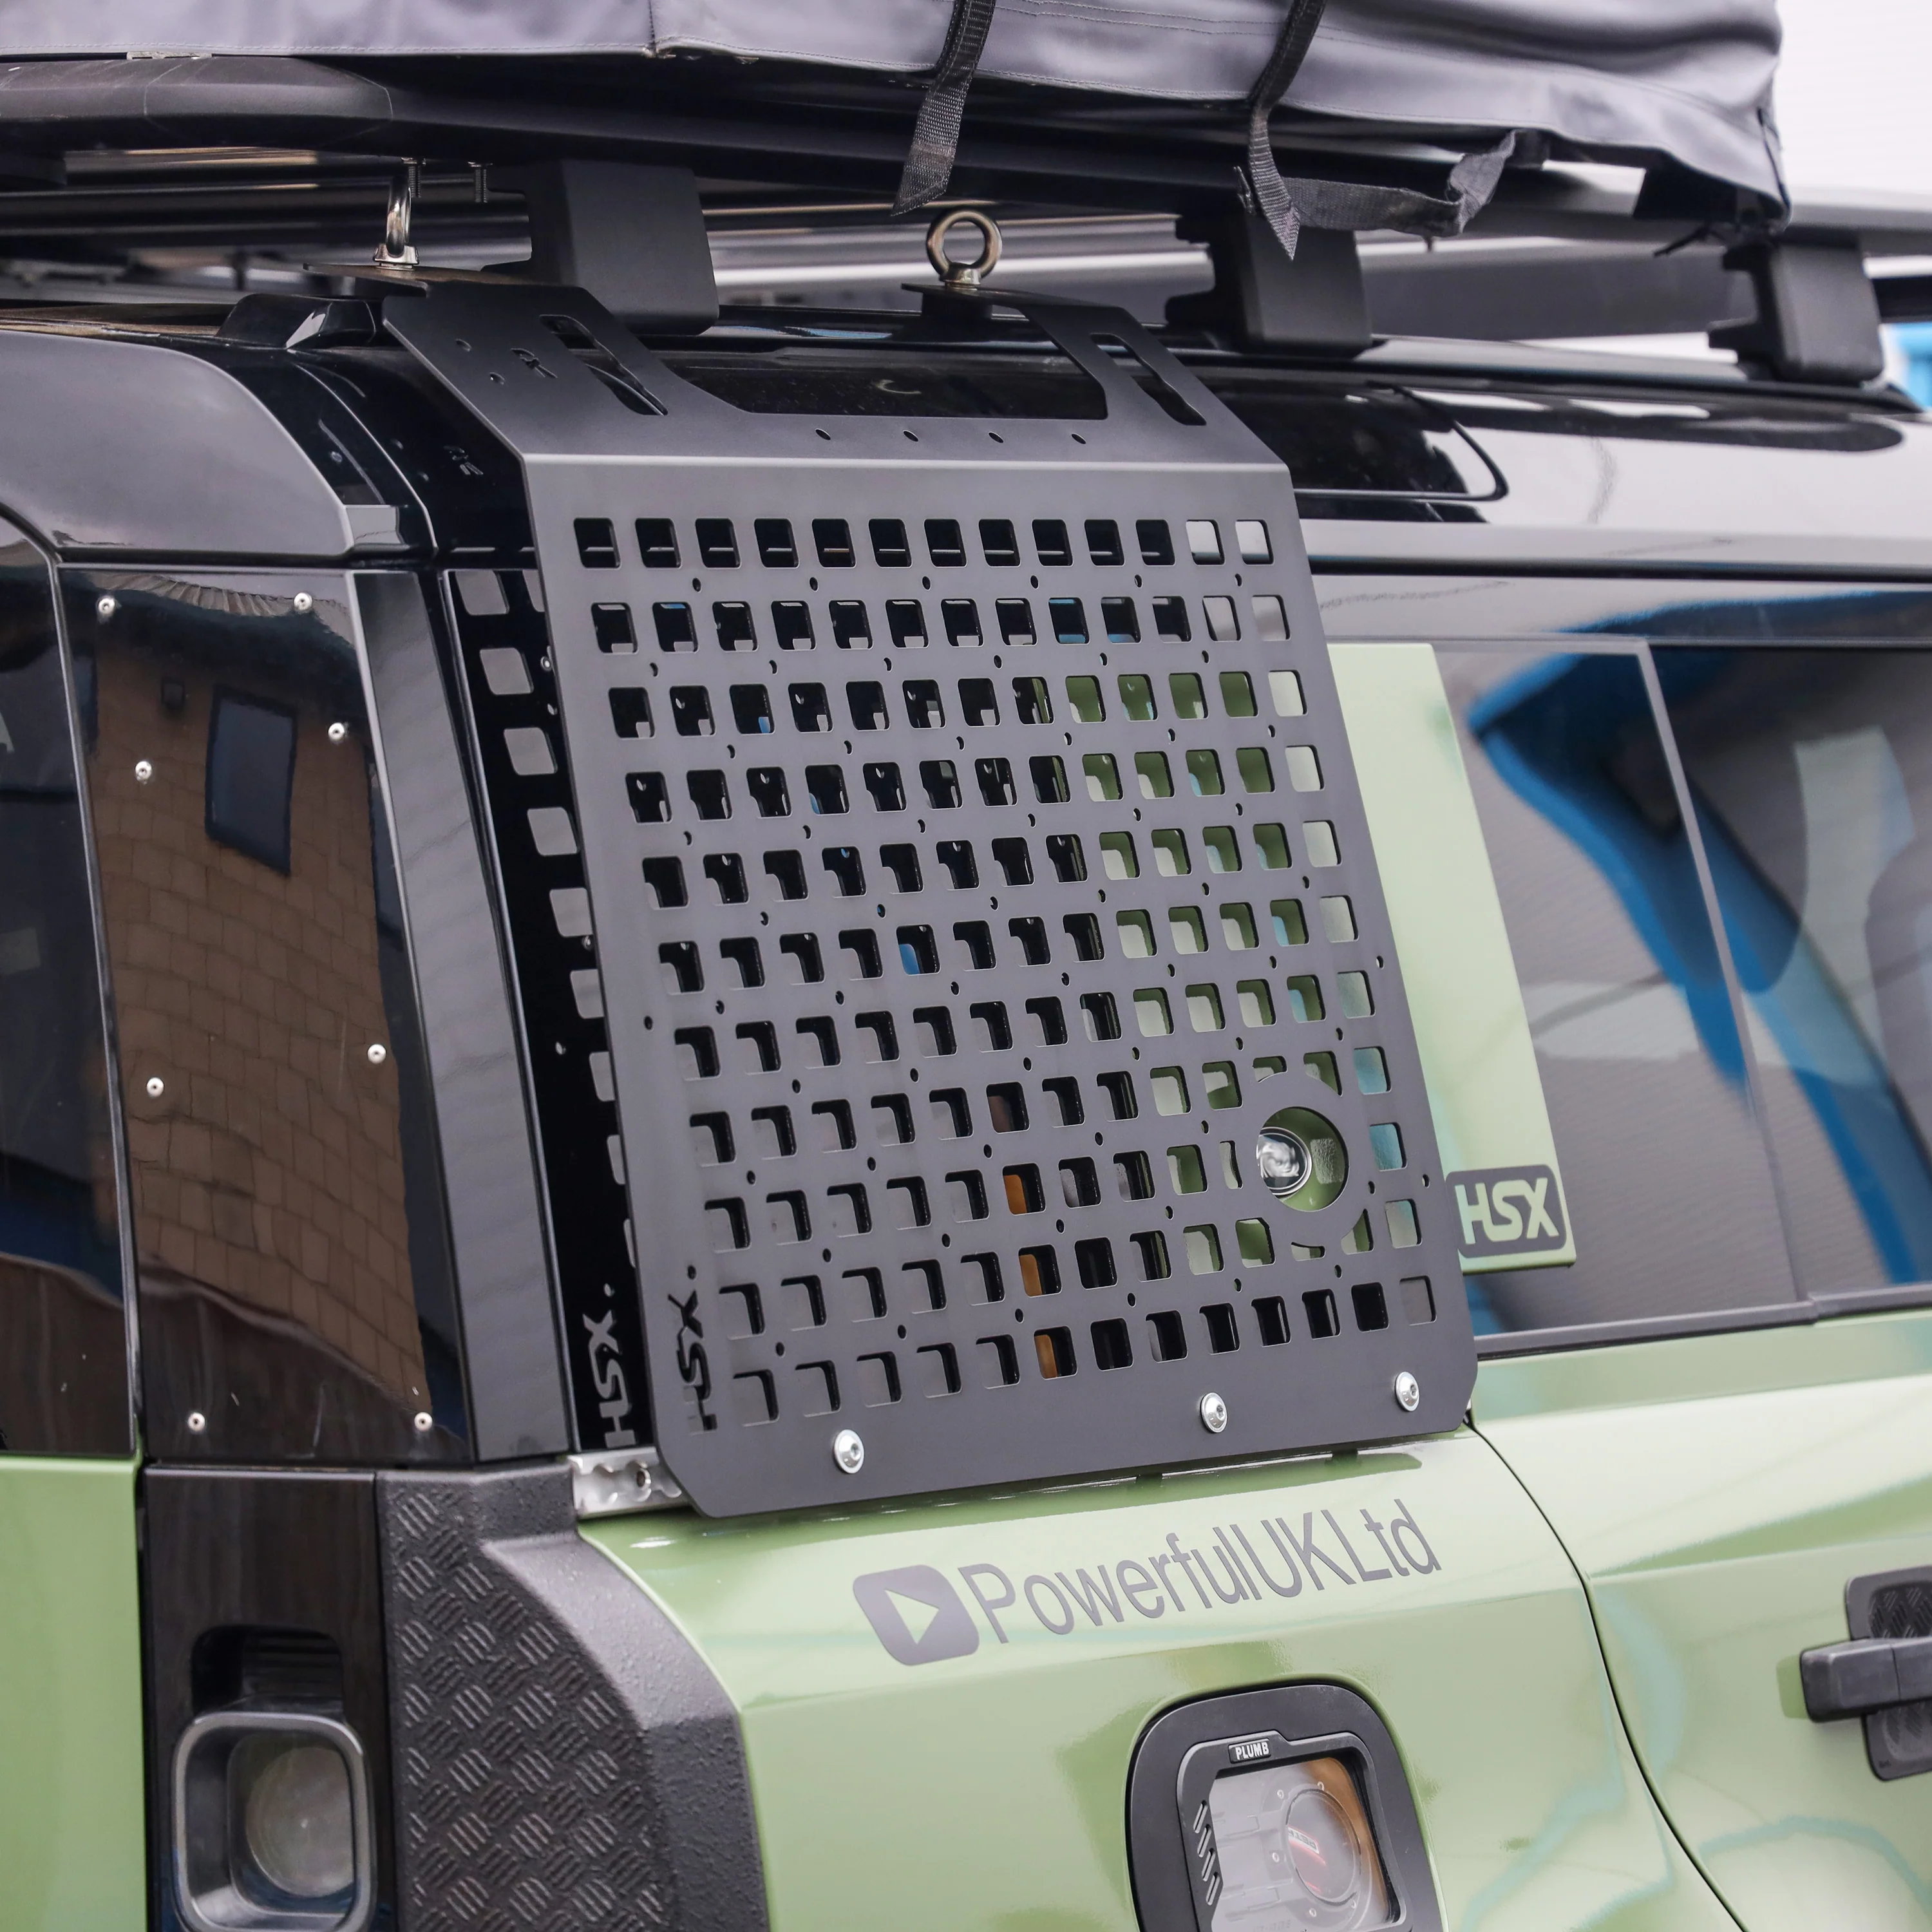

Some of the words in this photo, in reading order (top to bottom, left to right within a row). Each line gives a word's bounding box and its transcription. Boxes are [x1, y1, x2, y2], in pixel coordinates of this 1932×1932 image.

[1454, 1177, 1560, 1245] HSX
[668, 1290, 718, 1435] HSX
[957, 1499, 1441, 1643] PowerfulUKLtd
[1235, 1741, 1269, 1761] PLUMB
